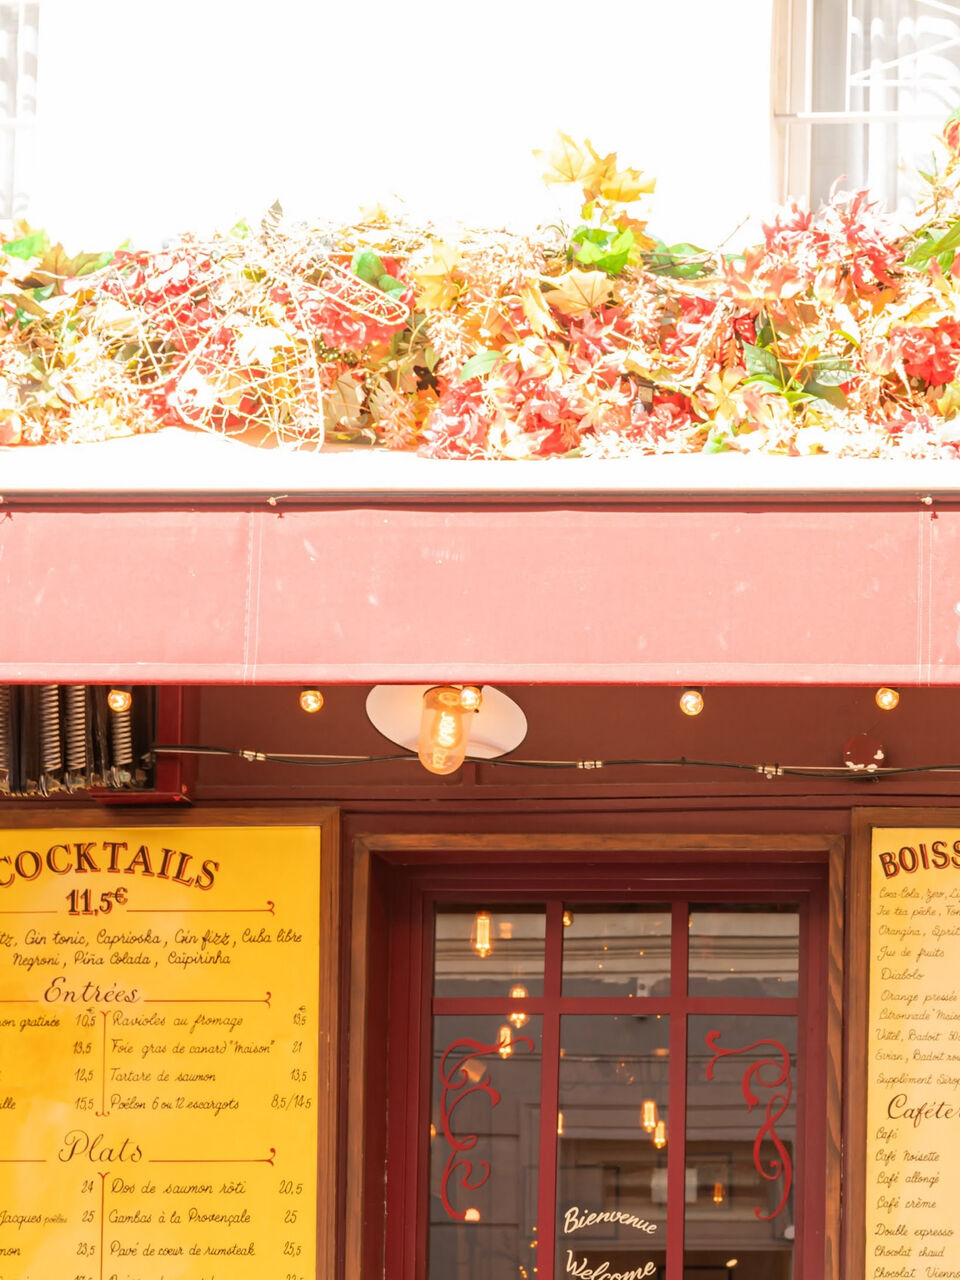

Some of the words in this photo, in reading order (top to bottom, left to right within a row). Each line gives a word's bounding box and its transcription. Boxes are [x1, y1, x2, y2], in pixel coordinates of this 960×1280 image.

[0, 841, 220, 891] COCKTAILS
[25, 929, 47, 945] Gin
[175, 929, 198, 944] Gin
[242, 928, 272, 943] Cuba
[276, 928, 303, 943] libre
[881, 967, 925, 980] Diabolo
[44, 976, 141, 1003] Entrées
[880, 989, 919, 1006] Orange
[112, 1010, 166, 1026] Ravioles
[173, 1018, 188, 1026] au
[189, 1013, 243, 1034] fromage
[111, 1038, 134, 1054] Foie
[141, 1045, 167, 1059] gras
[172, 1043, 185, 1054] de
[189, 1041, 228, 1054] canard
[111, 1067, 152, 1082] Tartare
[157, 1070, 169, 1082] de
[175, 1073, 216, 1082] saumon
[152, 1096, 160, 1110] 6
[175, 1096, 186, 1109] 12
[187, 1099, 239, 1117] escargots
[876, 1127, 899, 1144] Café
[58, 1129, 143, 1163] Plats
[875, 1148, 896, 1166] Café
[111, 1178, 135, 1194] Dos
[141, 1181, 156, 1194] de
[163, 1183, 213, 1194] saumon
[219, 1181, 246, 1194] rôti
[877, 1170, 900, 1188] Café
[905, 1171, 940, 1188] allongé
[876, 1195, 901, 1214] Café
[905, 1197, 937, 1209] crème
[82, 1210, 96, 1223] 25
[108, 1209, 152, 1224] Gambas
[158, 1211, 166, 1224] à
[169, 1211, 182, 1224] la
[188, 1207, 251, 1227] Provençale
[284, 1210, 298, 1224] 25
[564, 1206, 657, 1234] Bienvenue
[874, 1223, 908, 1236] Double
[913, 1227, 954, 1240] expresso
[110, 1240, 137, 1257] Pavé
[143, 1243, 155, 1256] de
[189, 1243, 201, 1256] de
[204, 1242, 256, 1256] rumsteak
[874, 1244, 912, 1257] Chocolat
[918, 1246, 946, 1257] chaud
[873, 1266, 916, 1279] Chocolat
